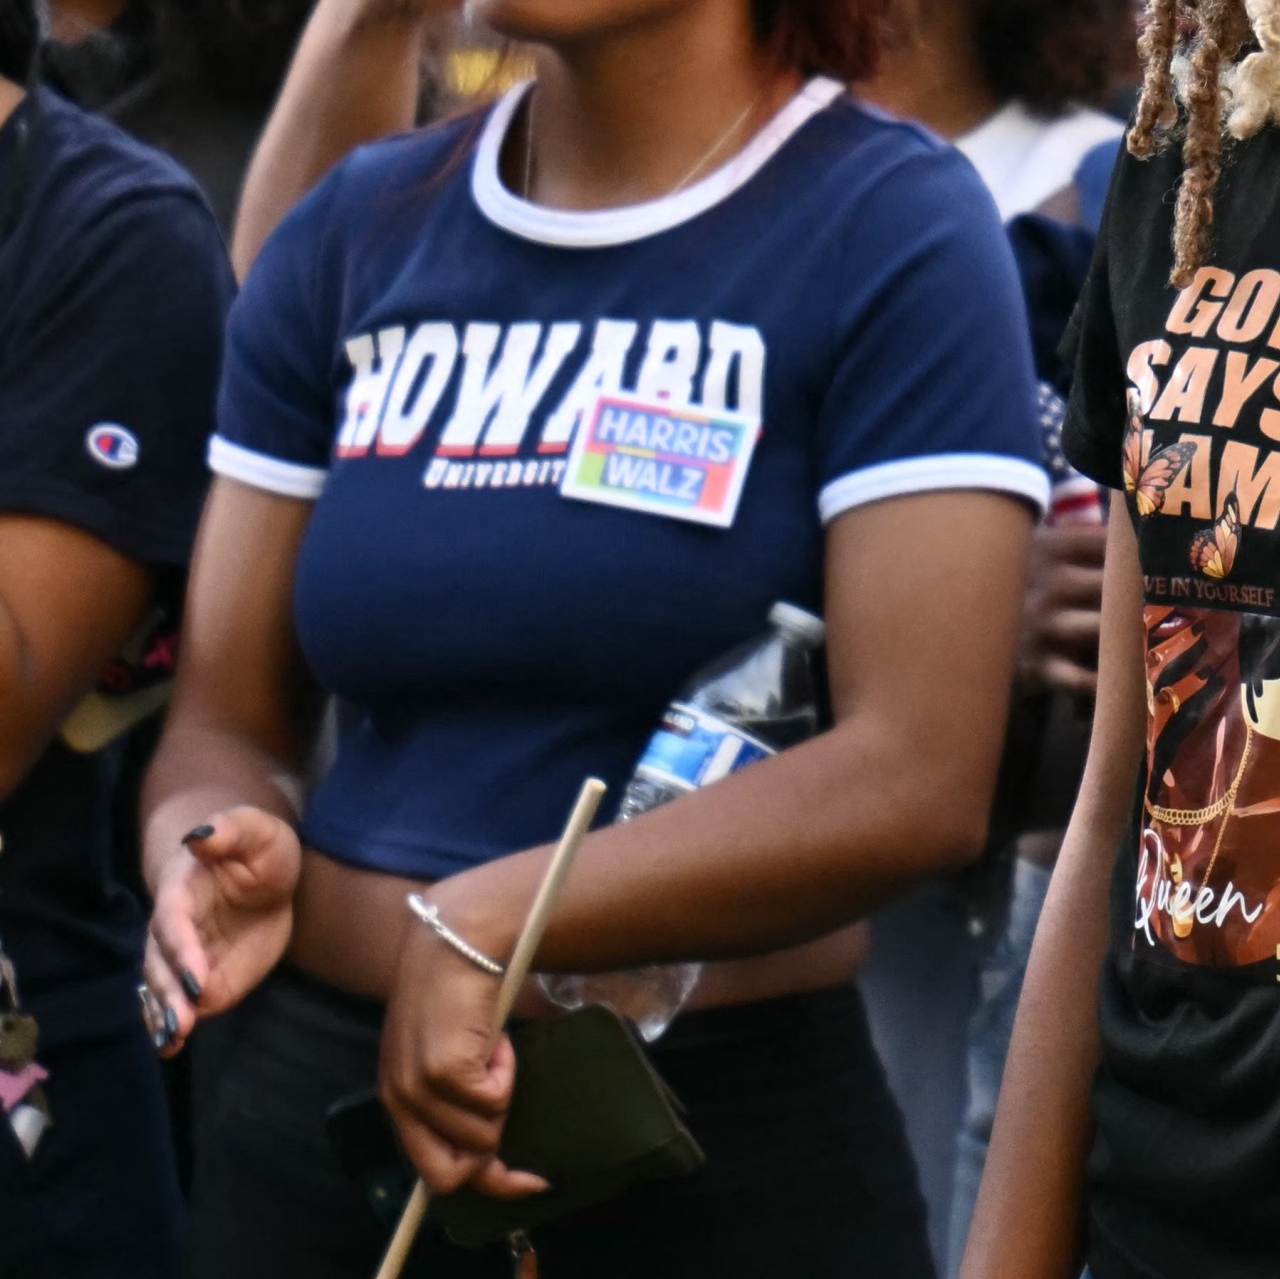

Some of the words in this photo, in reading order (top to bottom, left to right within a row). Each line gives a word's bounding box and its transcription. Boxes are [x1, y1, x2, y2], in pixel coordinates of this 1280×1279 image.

[337, 319, 766, 458] HOWARD
[598, 407, 734, 463] HARRIS
[423, 458, 565, 489] UNIVERSIT
[607, 453, 704, 500] WALZ
[1170, 577, 1190, 598] IN
[1194, 579, 1275, 607] YOURSELF
[1134, 828, 1263, 947] Queen
